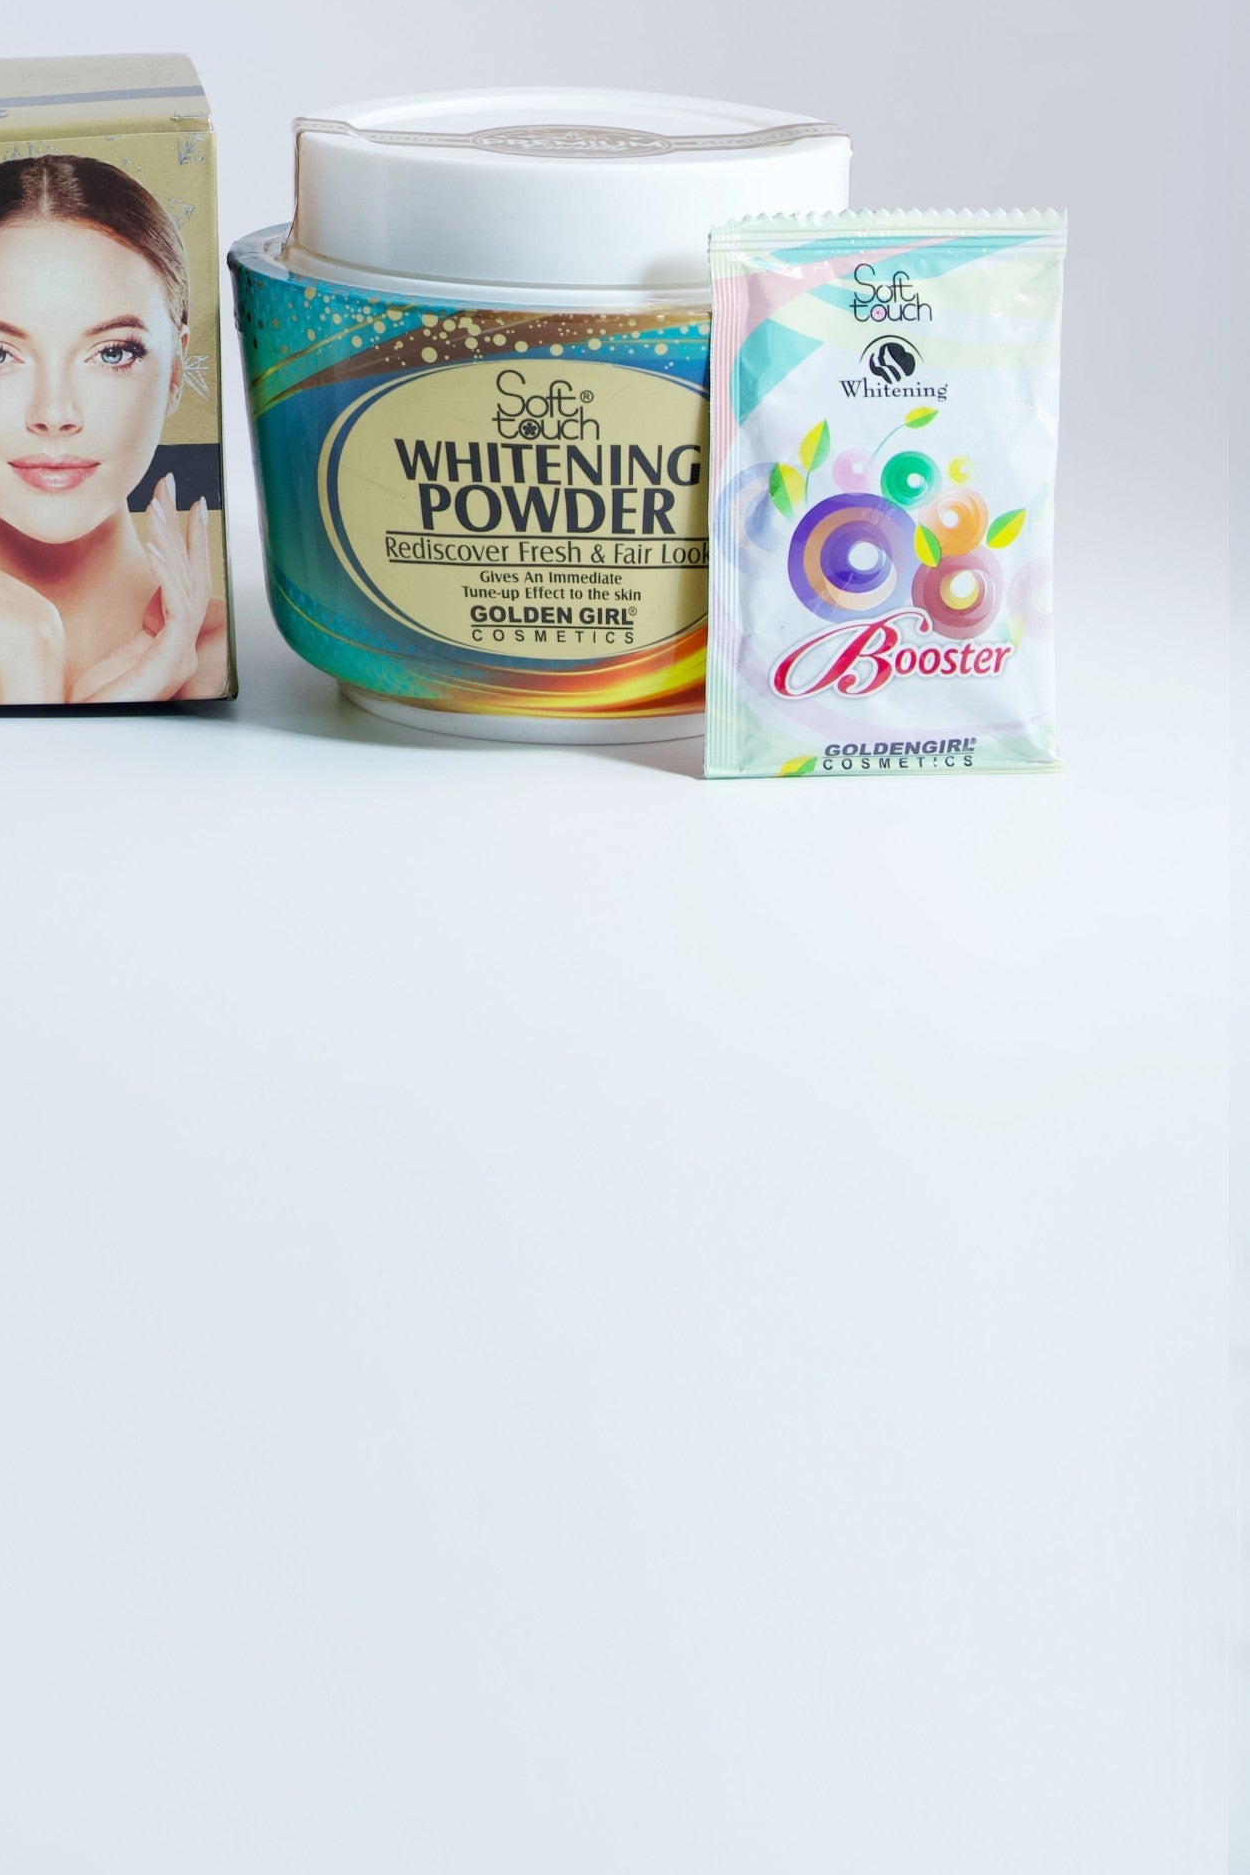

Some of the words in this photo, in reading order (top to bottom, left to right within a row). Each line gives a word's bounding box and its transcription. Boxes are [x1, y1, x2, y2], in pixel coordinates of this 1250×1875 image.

[854, 263, 916, 304] Soft
[849, 292, 933, 323] touch
[496, 369, 578, 418] Soft
[839, 377, 949, 402] Whitening
[492, 406, 599, 441] touch
[394, 438, 701, 486] WHITENING
[418, 482, 676, 535] POWDER
[385, 536, 509, 563] Rediscover
[519, 541, 581, 564] Fresh
[591, 544, 605, 564] &
[614, 543, 653, 564] Fair
[661, 542, 709, 564] Look
[480, 570, 519, 584] Gives
[524, 571, 544, 584] An
[548, 571, 623, 585] Immediate
[462, 585, 520, 601] Tune-up
[525, 586, 566, 600] Effect
[569, 589, 584, 600] to
[587, 587, 610, 601] the
[614, 588, 642, 602] skin
[470, 605, 573, 625] GOLDEN
[471, 628, 635, 645] COSMETICS
[772, 609, 1013, 698] Booster
[822, 755, 973, 771] COSMETICS
